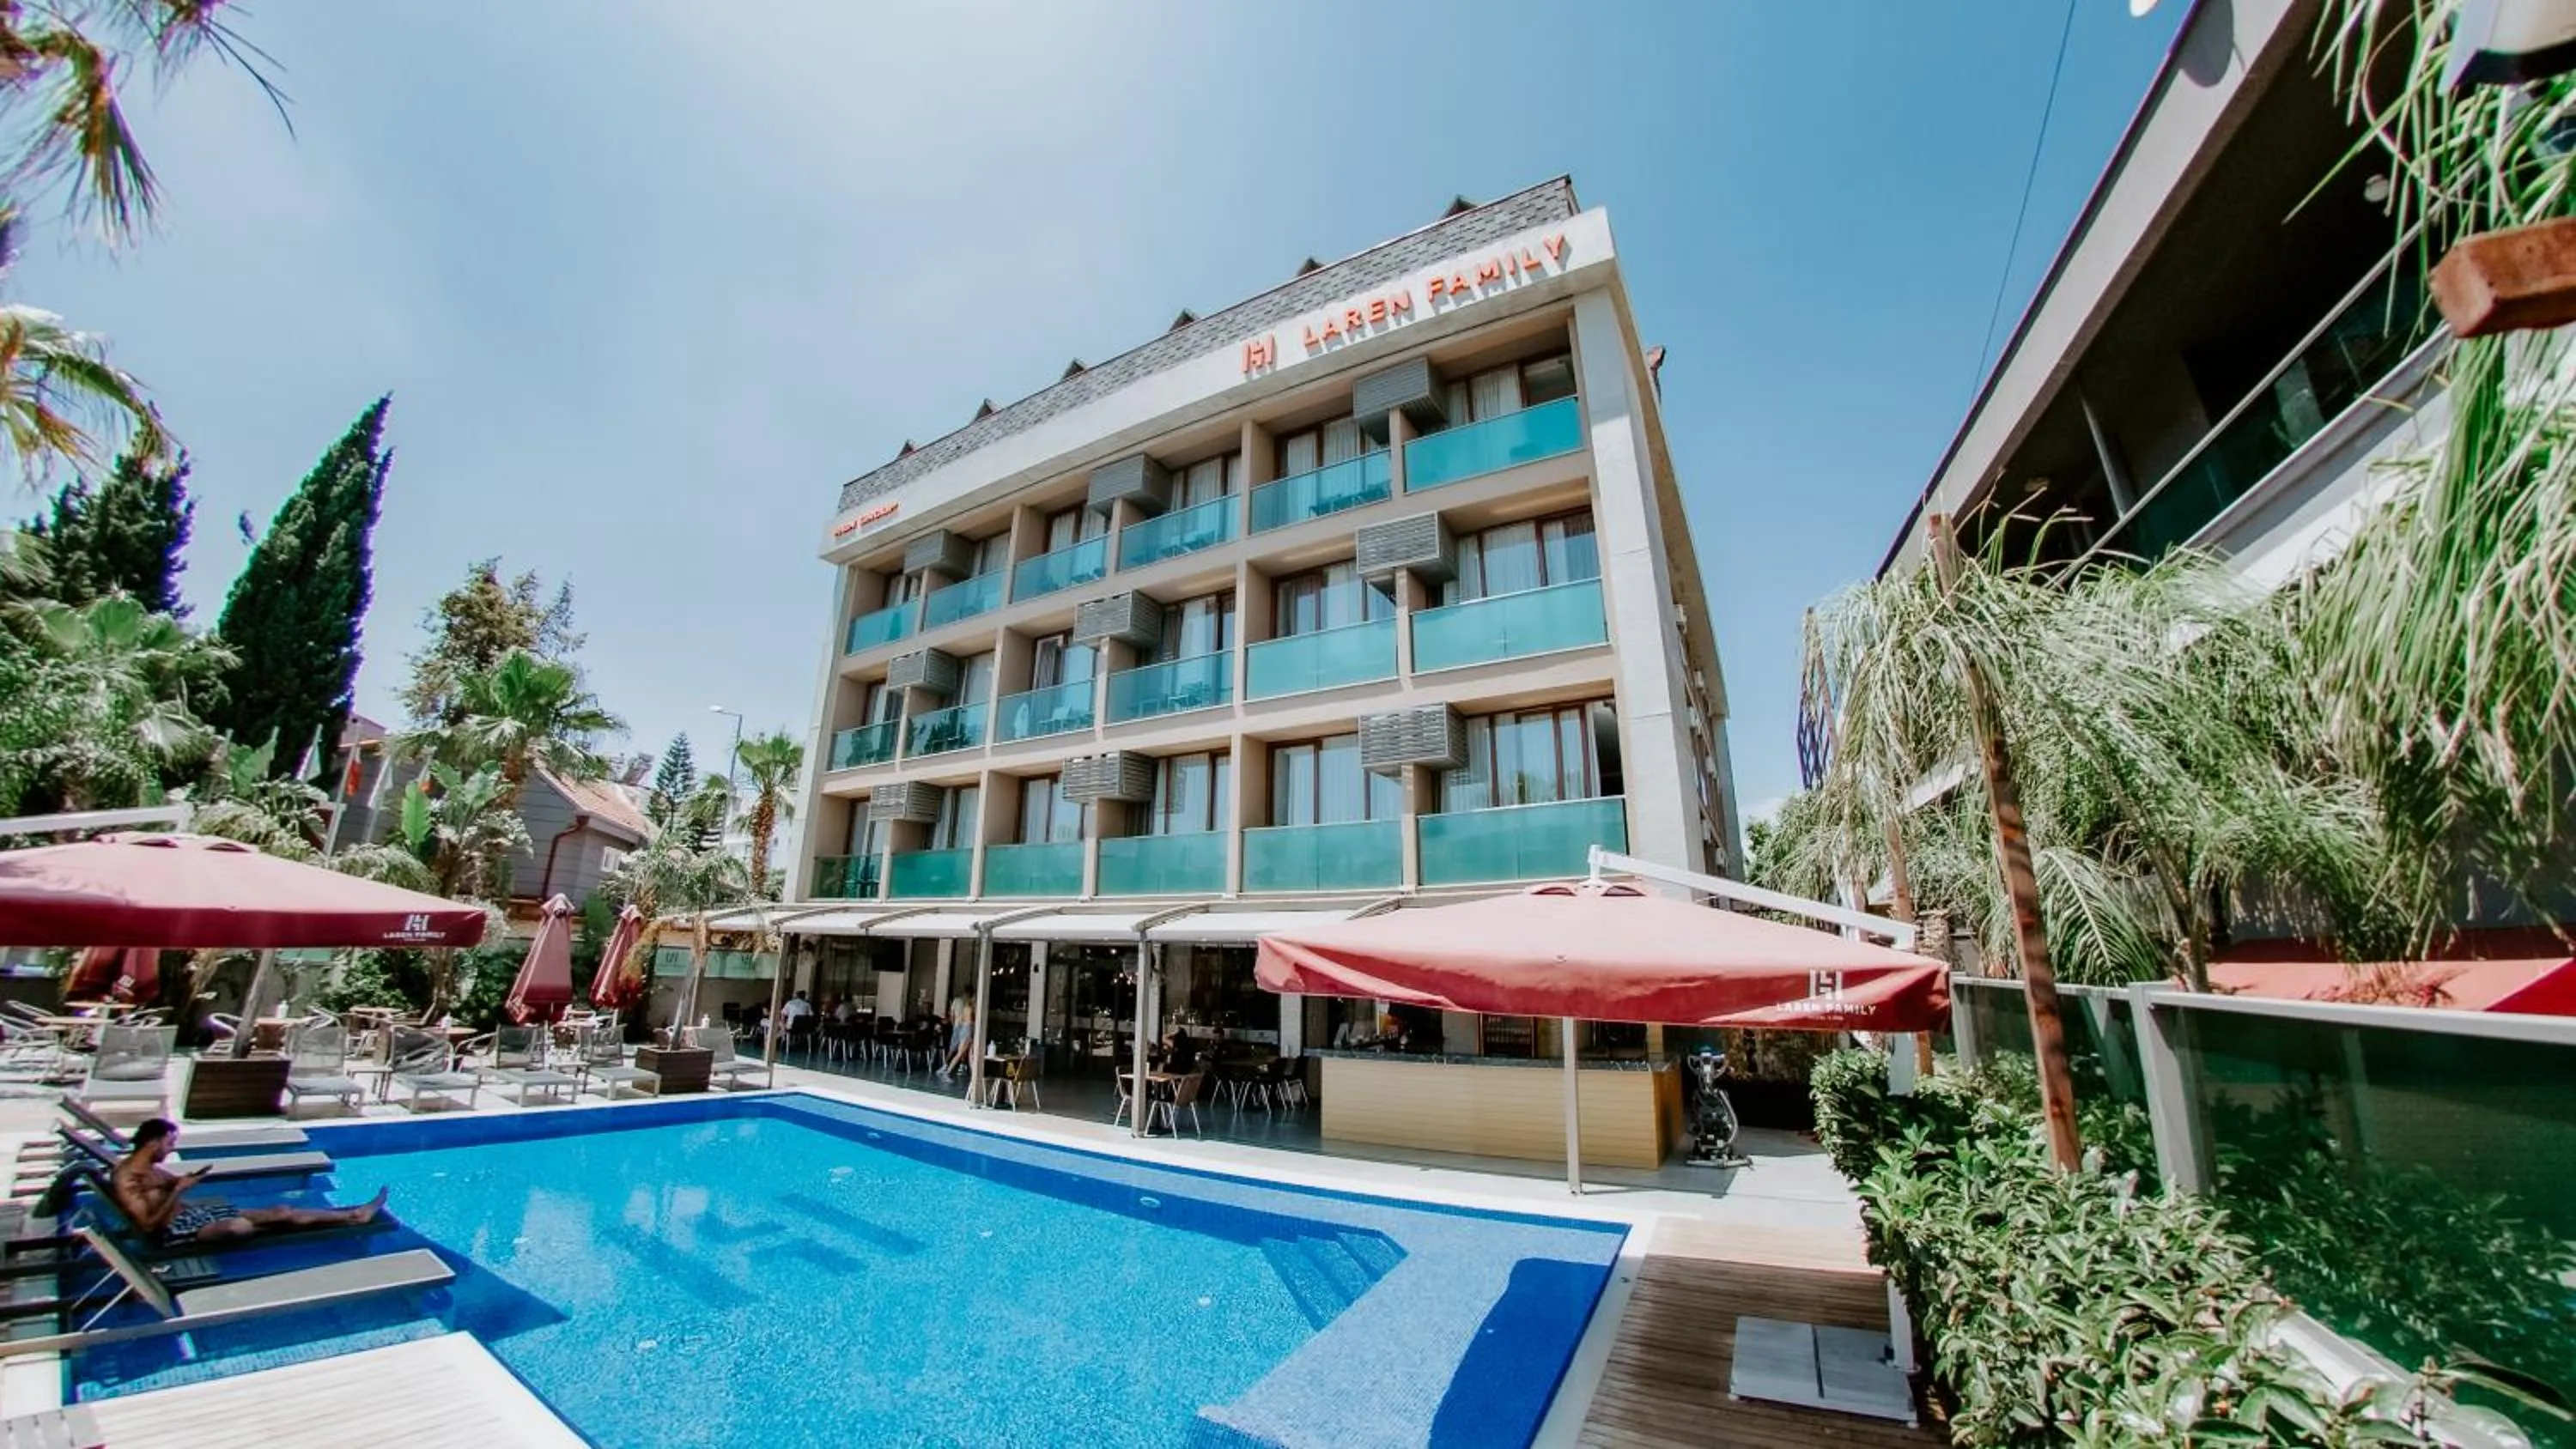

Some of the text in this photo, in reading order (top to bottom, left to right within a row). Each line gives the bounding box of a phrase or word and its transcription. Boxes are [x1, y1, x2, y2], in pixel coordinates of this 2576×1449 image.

[1303, 288, 1412, 348] LAREN
[1428, 232, 1566, 303] FAMILY
[1826, 1003, 1877, 1016] FAMILY
